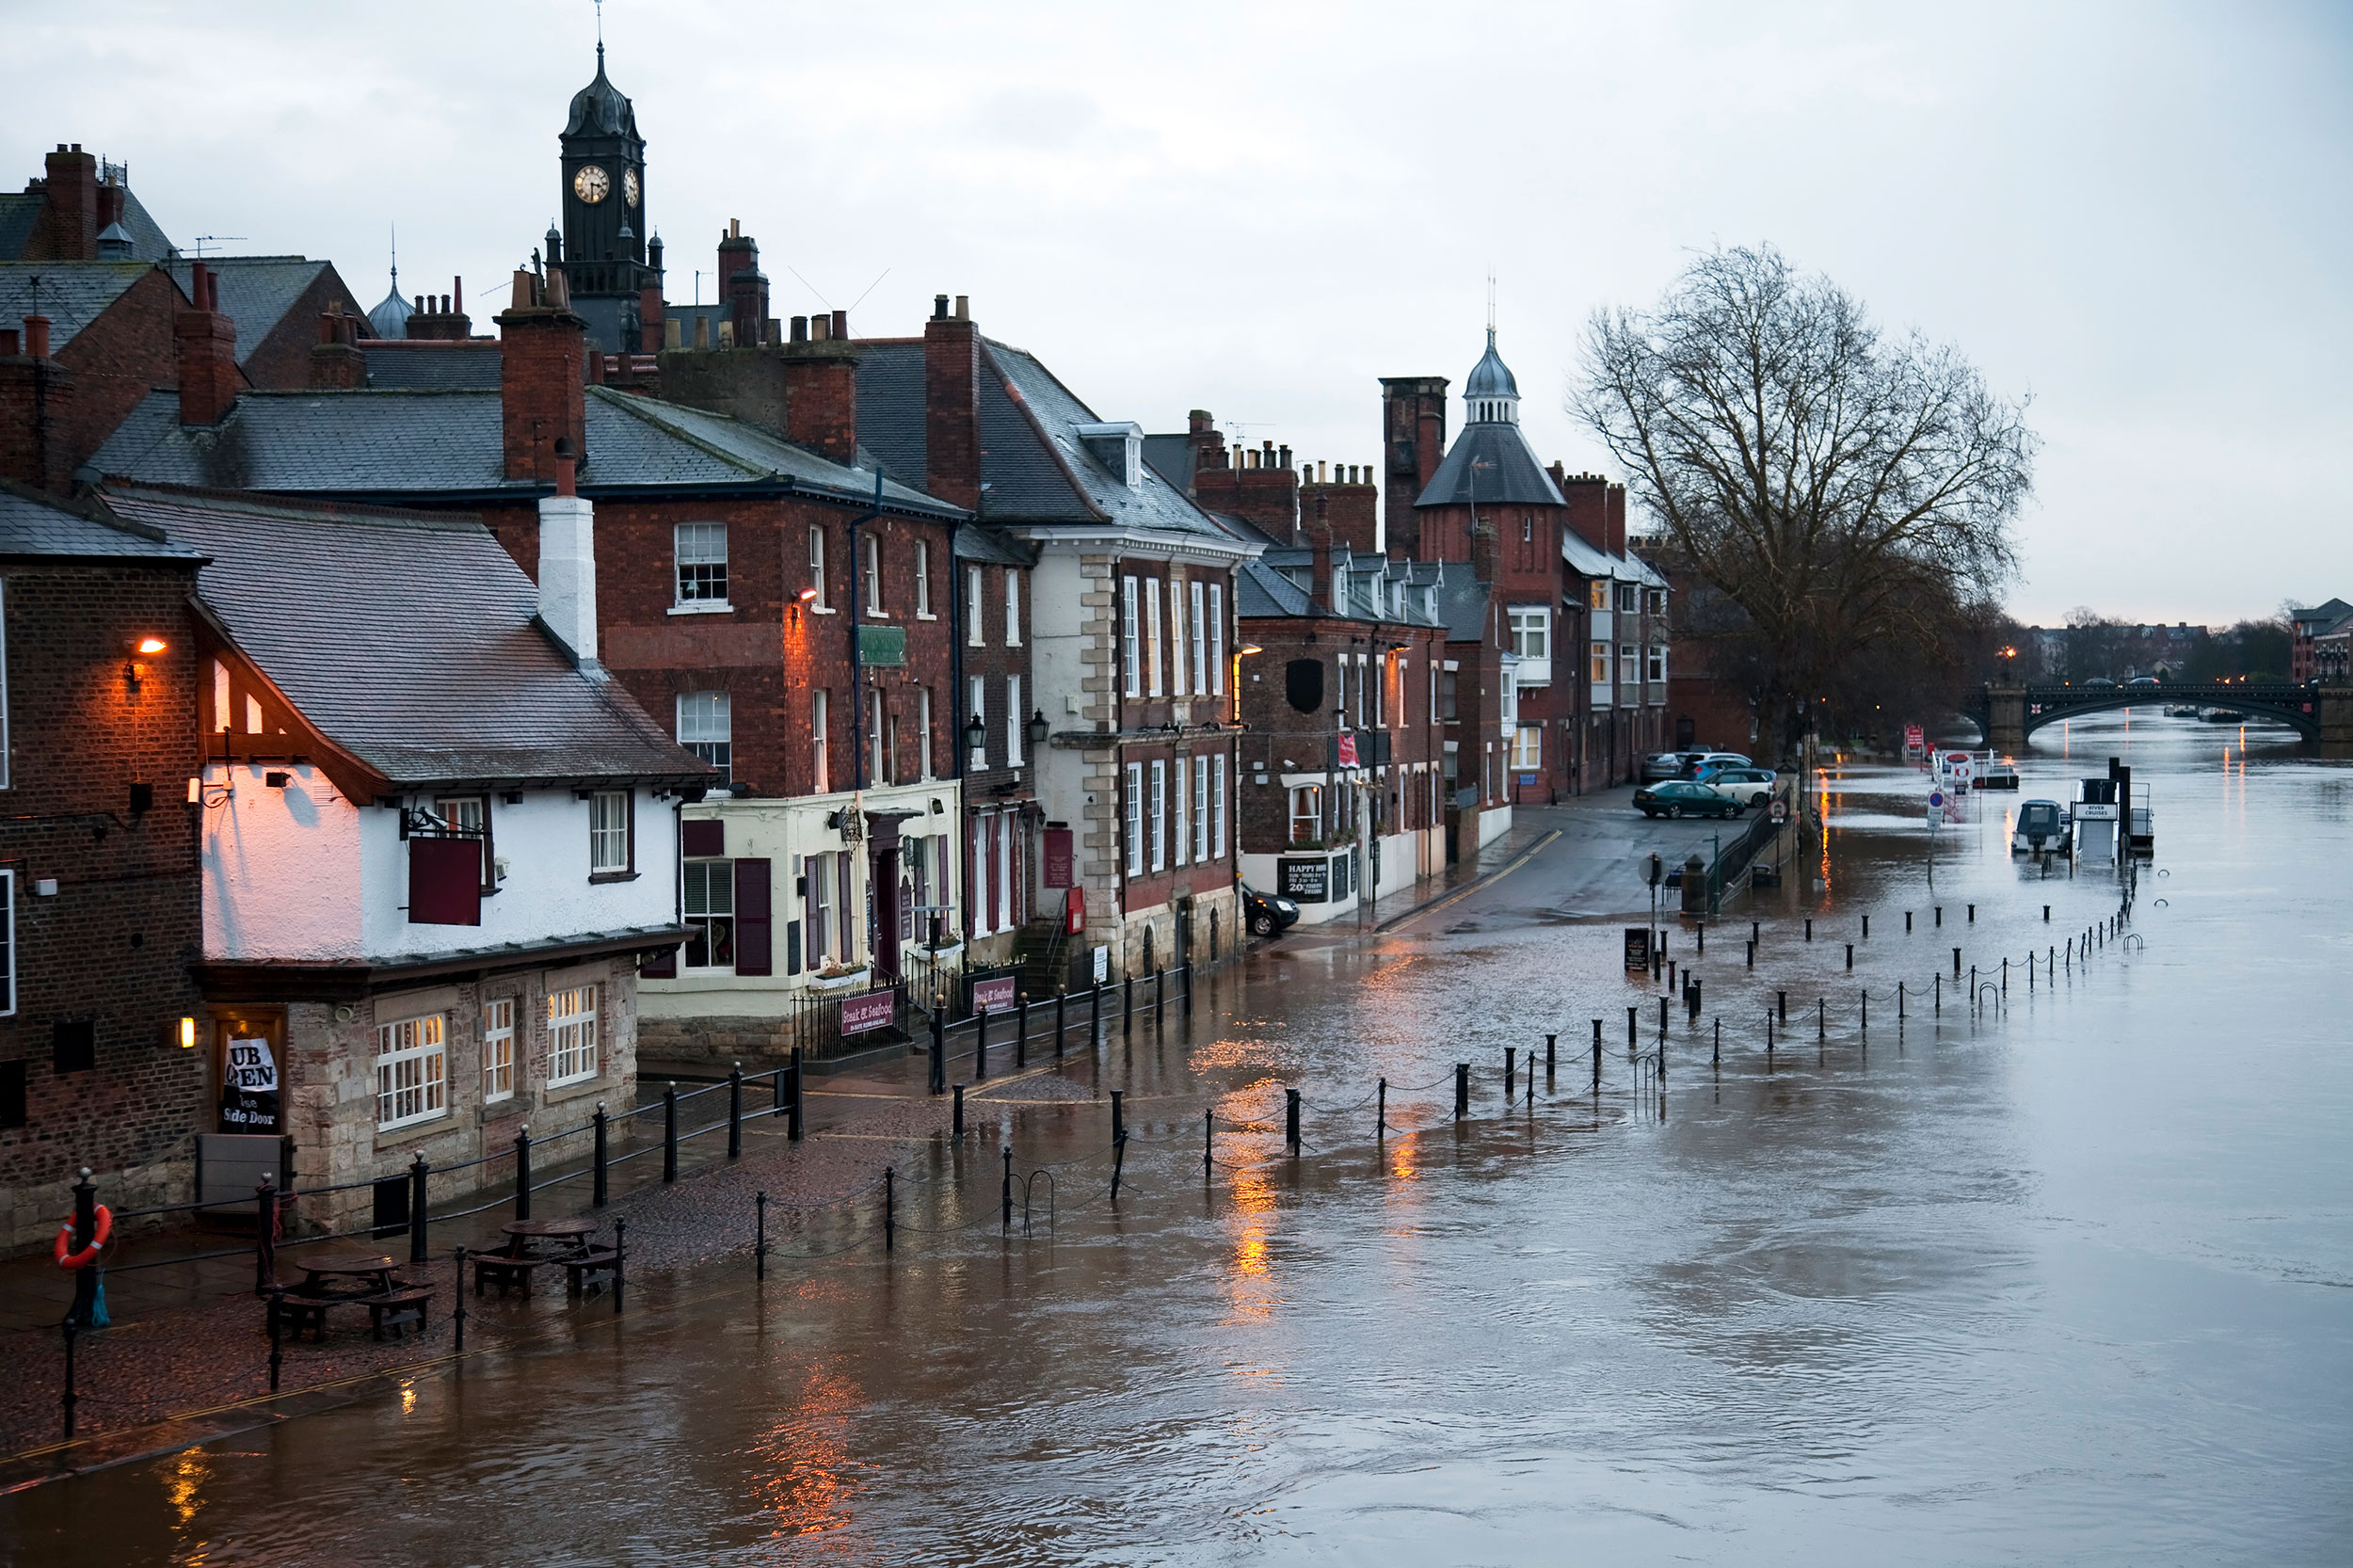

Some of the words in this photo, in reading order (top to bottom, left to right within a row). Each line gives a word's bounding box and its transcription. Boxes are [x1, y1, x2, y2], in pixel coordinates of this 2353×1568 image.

[1289, 864, 1315, 872] HAPPY
[994, 986, 1014, 1000] Seafood
[843, 1008, 860, 1023] Steak
[860, 1007, 868, 1020] &
[869, 1000, 892, 1017] Seafood
[230, 1047, 262, 1066] UB
[223, 1108, 247, 1123] Sde
[248, 1111, 275, 1125] Door
